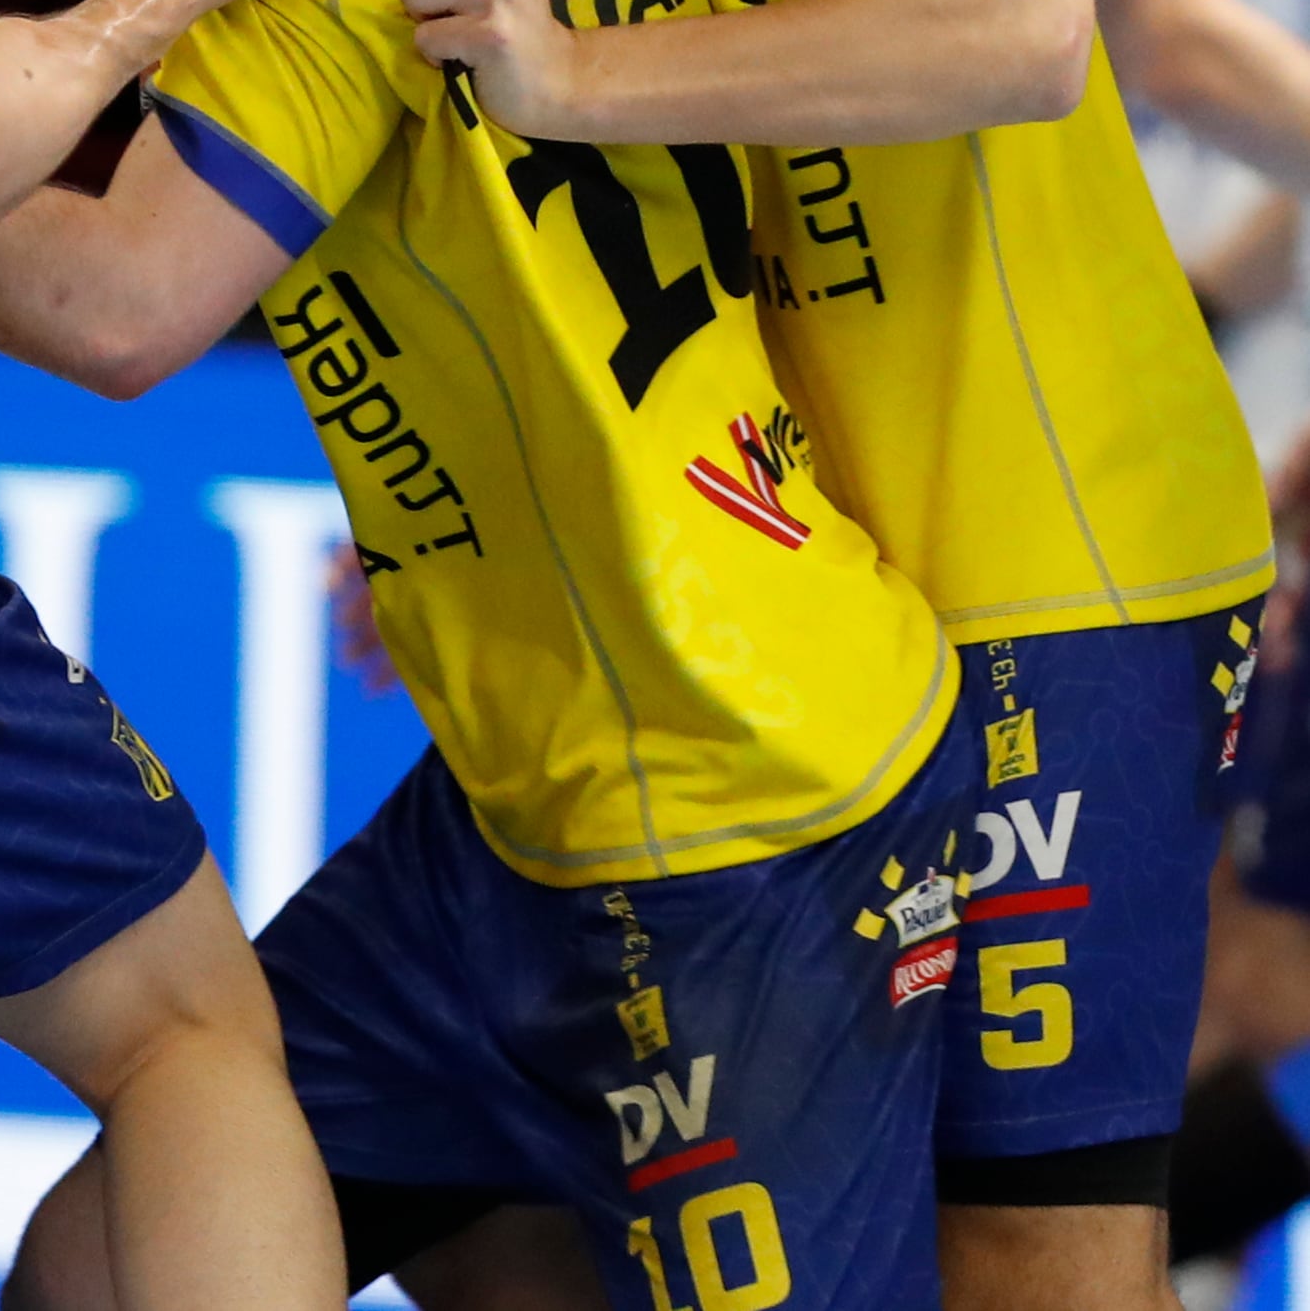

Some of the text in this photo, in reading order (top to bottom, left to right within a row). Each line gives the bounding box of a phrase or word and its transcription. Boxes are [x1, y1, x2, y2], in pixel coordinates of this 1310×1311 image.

[273, 284, 484, 558] irudek
[979, 937, 1074, 1072] 5
[605, 1053, 717, 1167] DV
[627, 1181, 792, 1311] 10
